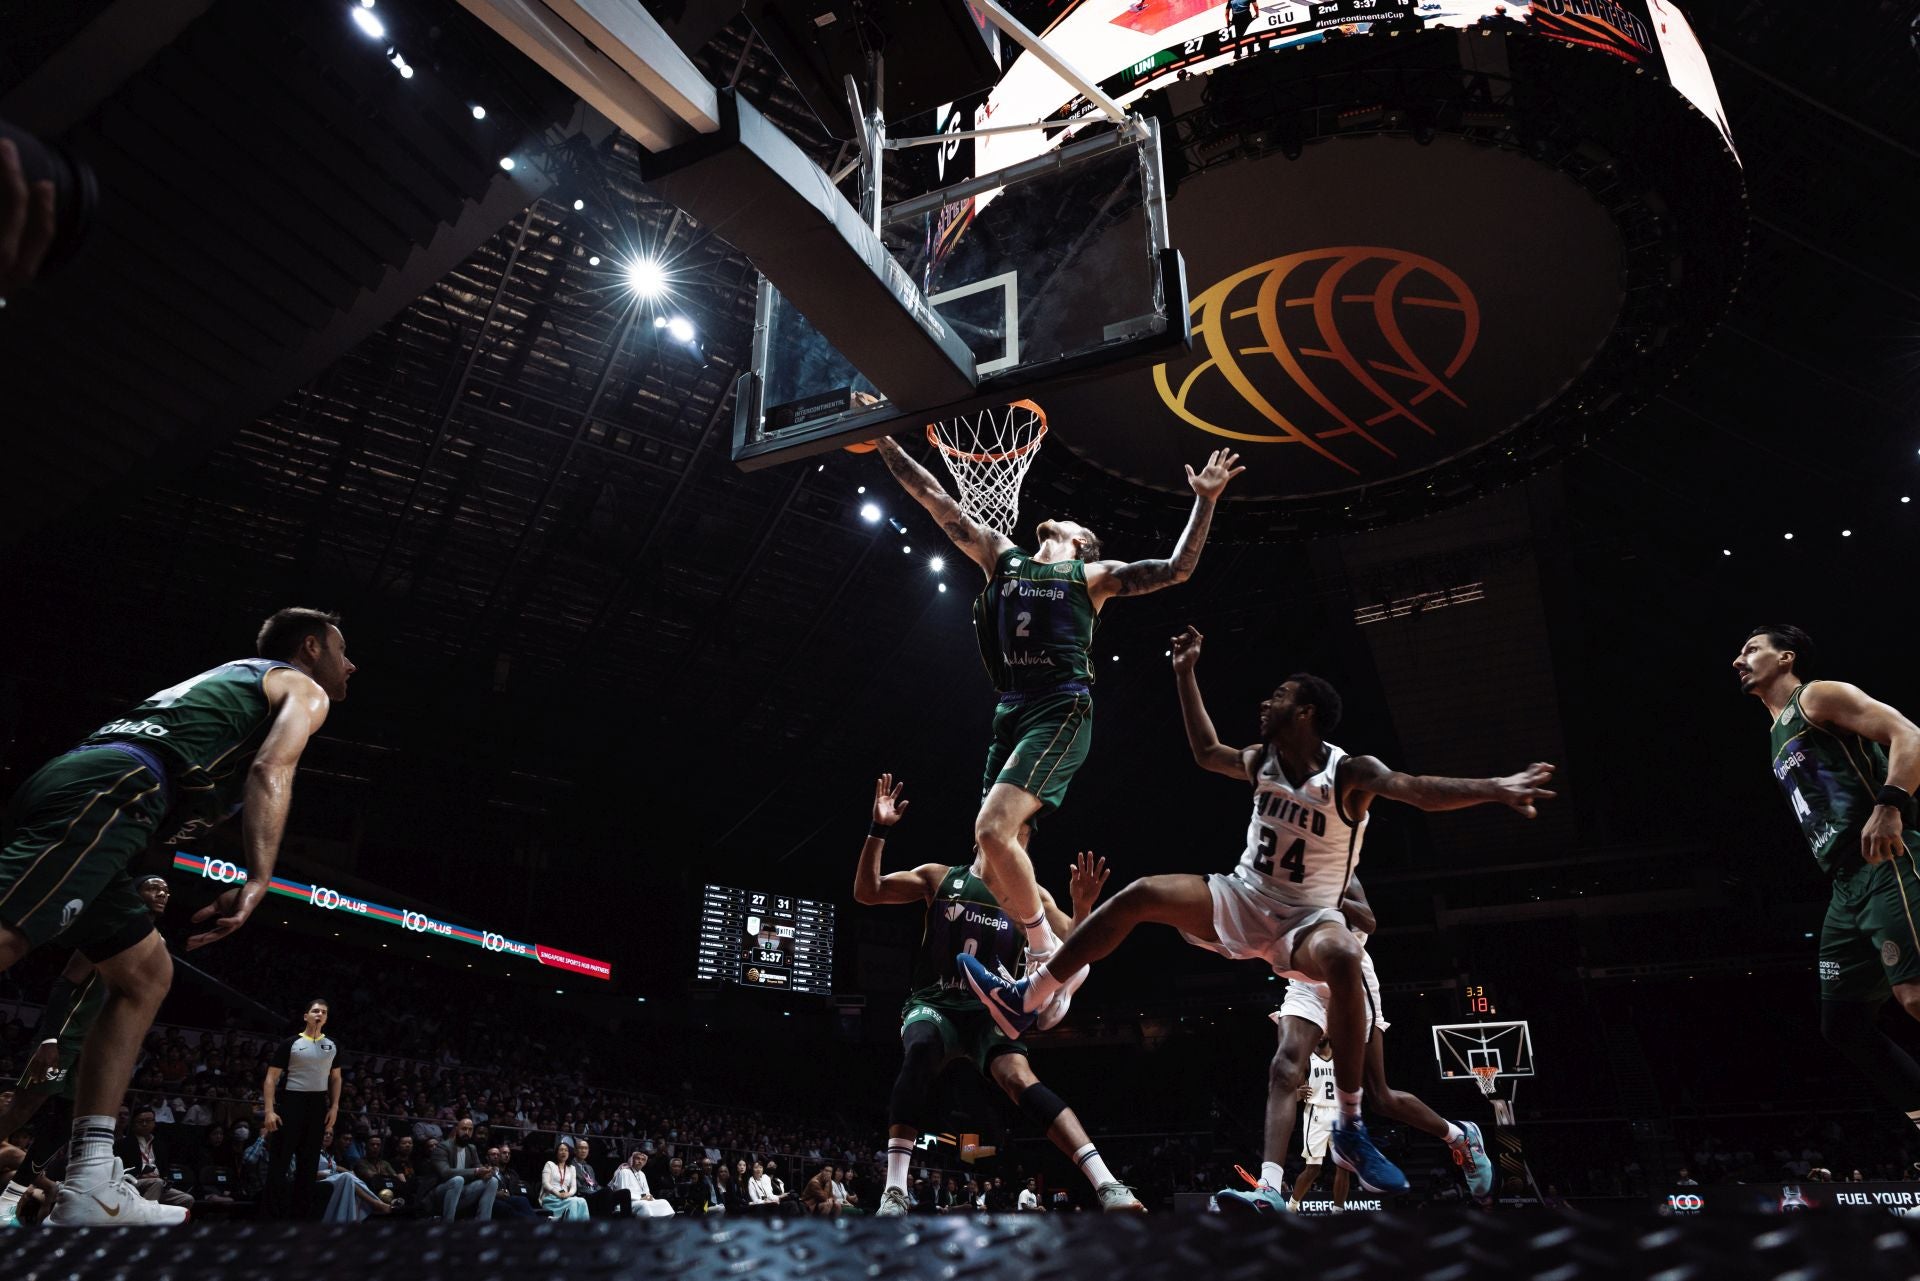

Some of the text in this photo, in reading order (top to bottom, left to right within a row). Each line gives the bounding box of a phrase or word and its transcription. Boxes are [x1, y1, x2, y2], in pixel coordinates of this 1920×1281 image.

[1318, 3, 1339, 15] 2nd
[1353, 0, 1377, 9] 3:37
[1268, 11, 1295, 26] GLU
[1316, 11, 1405, 28] #IntercontinentalCup
[1218, 25, 1237, 42] 31
[1183, 36, 1204, 55] 27
[1134, 57, 1156, 75] UNI
[1019, 586, 1065, 600] Unicaja
[1015, 611, 1032, 637] 2
[1257, 791, 1326, 838] UNITED
[1253, 825, 1306, 884] 24
[308, 884, 368, 914] 100PLUS
[752, 894, 766, 906] 27
[777, 898, 789, 910] 31
[401, 908, 453, 936] 100PLUS
[965, 910, 1008, 931] Unicaja
[482, 930, 526, 954] 100PLUS
[540, 951, 565, 963] SINGAPORE
[565, 957, 581, 968] SPORTS
[590, 964, 610, 975] PARTNERS
[760, 951, 782, 963] 3:37
[1472, 997, 1488, 1012] 18
[1302, 1200, 1382, 1212] PERFOMANCE
[1669, 1194, 1702, 1210] 100
[1836, 1192, 1873, 1205] FUEL
[1871, 1192, 1914, 1205] YOUR
